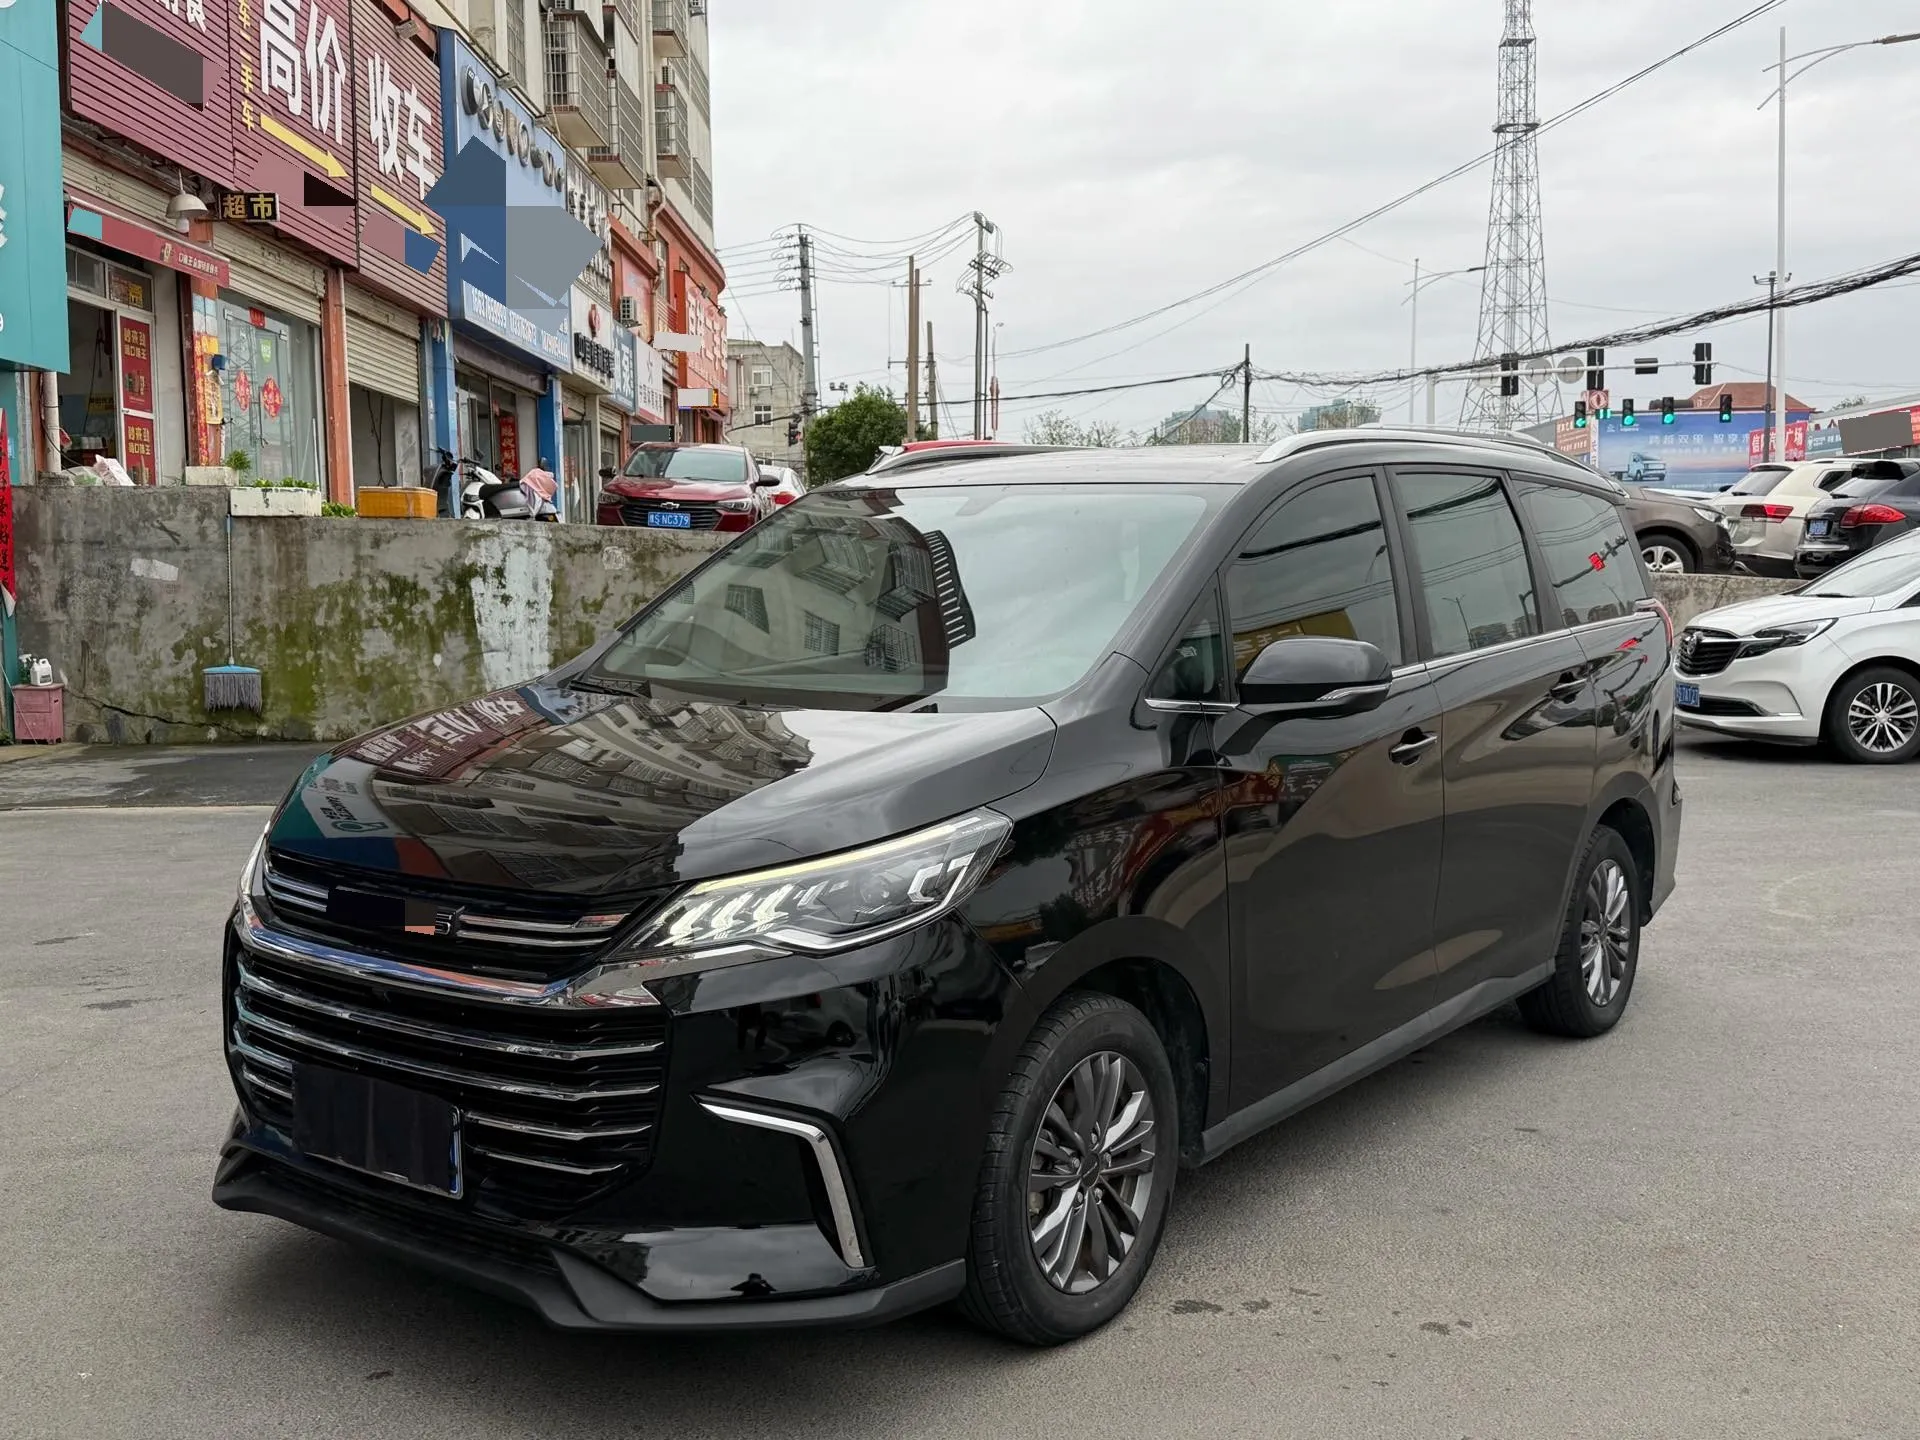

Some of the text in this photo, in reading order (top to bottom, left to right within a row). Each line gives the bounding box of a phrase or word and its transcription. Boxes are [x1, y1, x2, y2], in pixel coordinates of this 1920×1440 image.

[260, 0, 436, 201] 高价 收车
[222, 194, 274, 219] 超市
